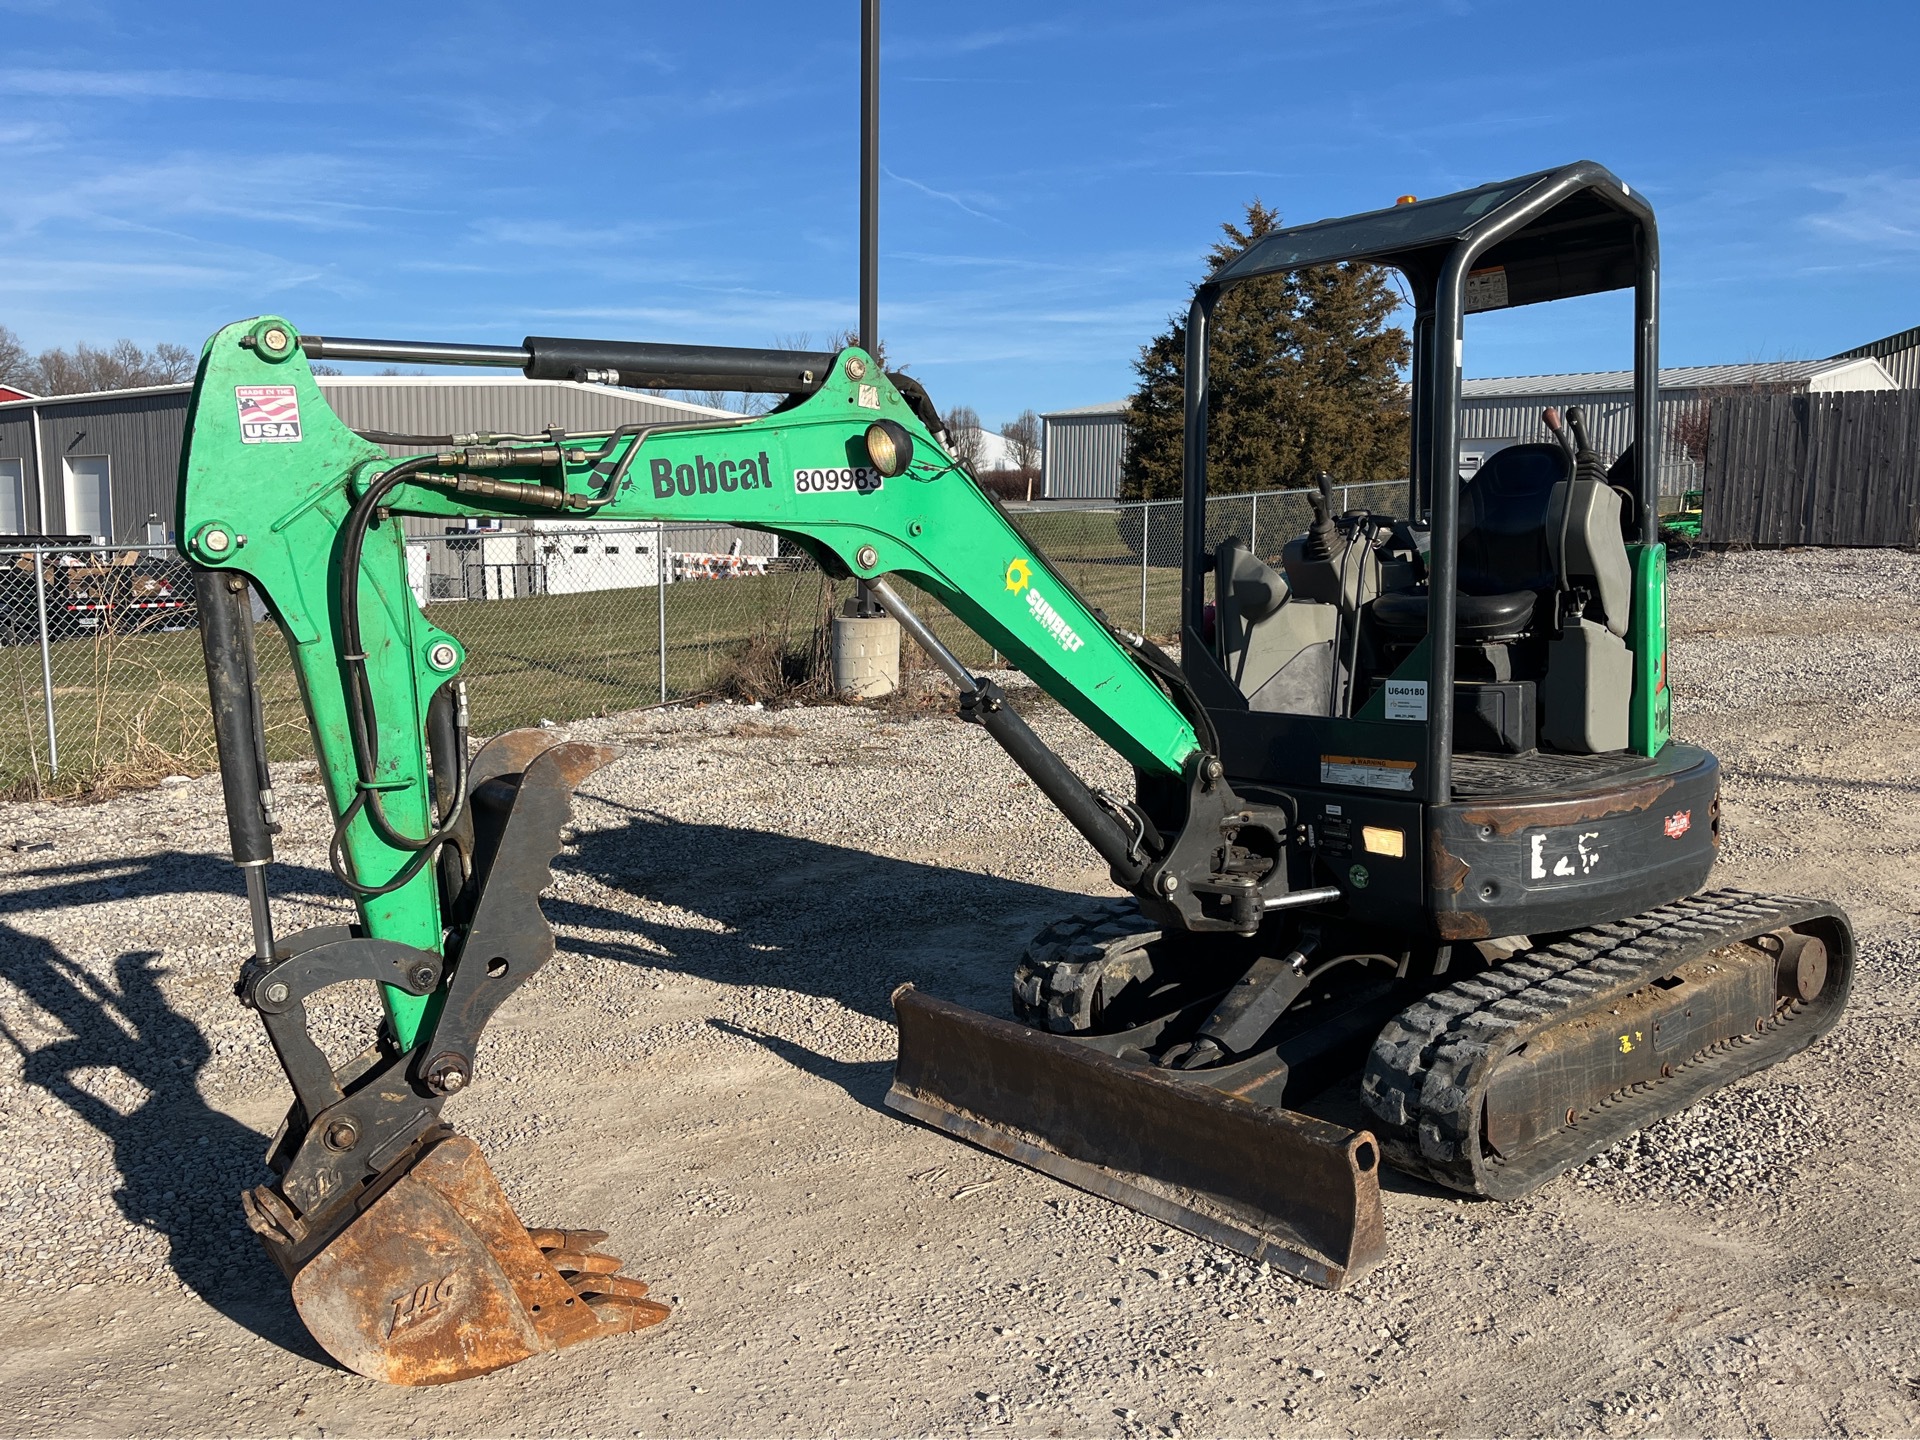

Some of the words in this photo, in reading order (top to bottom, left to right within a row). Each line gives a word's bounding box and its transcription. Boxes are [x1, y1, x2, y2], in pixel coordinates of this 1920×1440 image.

[244, 423, 297, 438] USA
[650, 451, 772, 499] Bobcat
[796, 468, 882, 493] 809983
[1025, 588, 1085, 653] SUNBELT
[1029, 607, 1069, 652] RENTALS
[1388, 687, 1425, 696] U640180
[1358, 759, 1387, 767] WARNING
